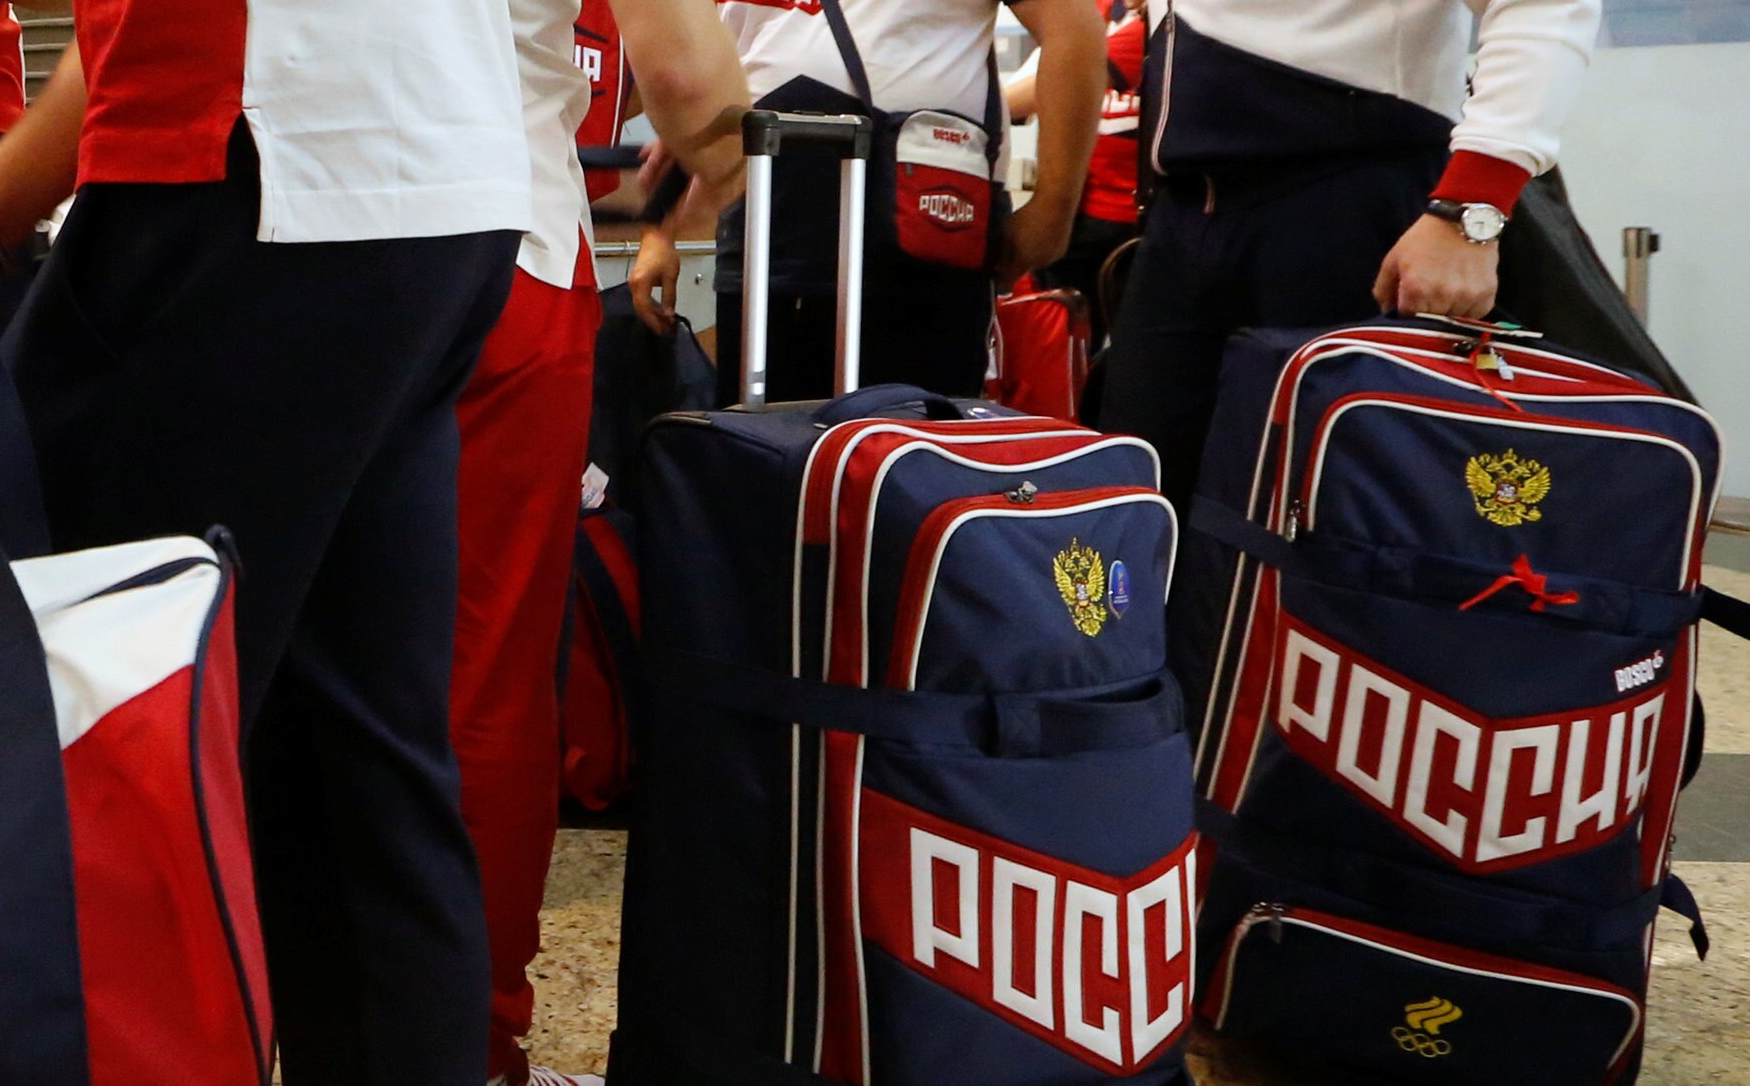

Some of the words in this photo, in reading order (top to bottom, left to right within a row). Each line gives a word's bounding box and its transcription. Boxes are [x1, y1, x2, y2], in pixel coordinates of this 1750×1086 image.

[919, 195, 974, 222] РОССИЯ
[1614, 658, 1655, 693] BOSCO
[1279, 629, 1665, 863] РОССИЯ
